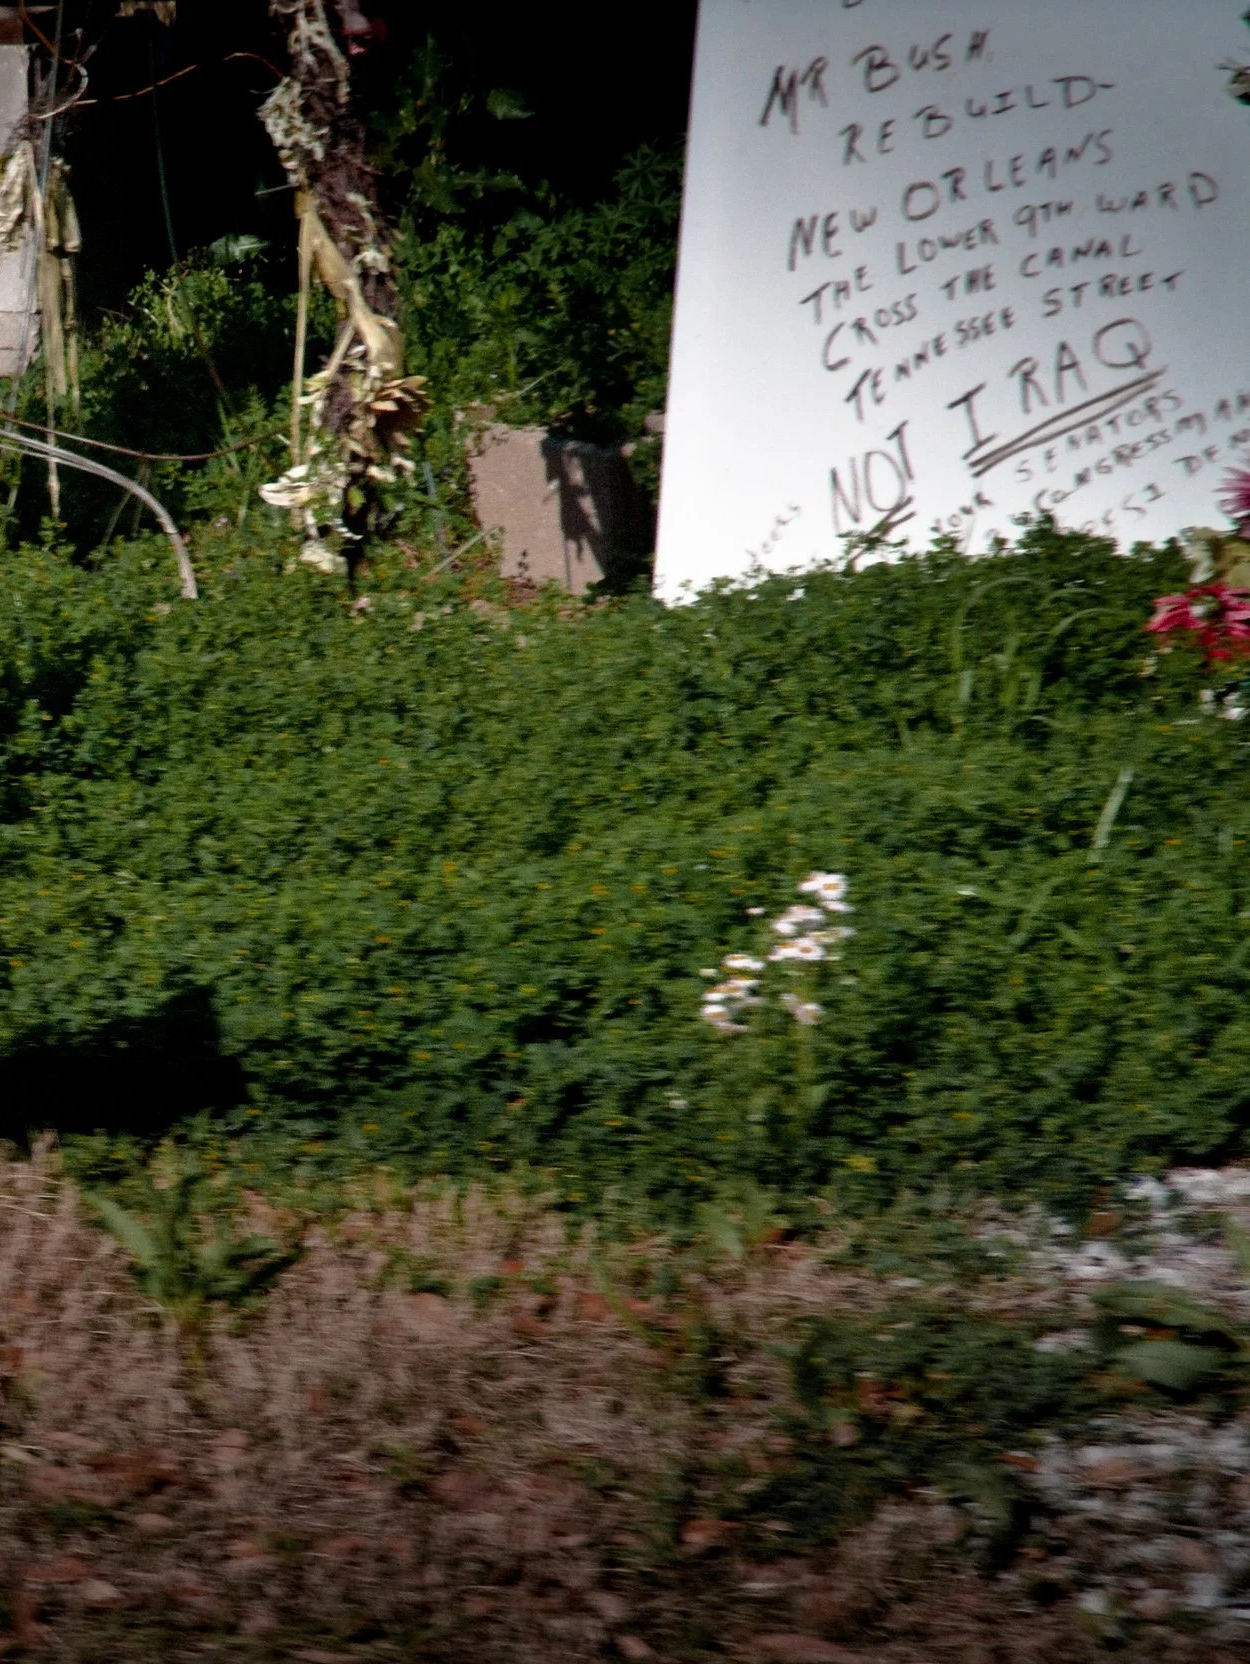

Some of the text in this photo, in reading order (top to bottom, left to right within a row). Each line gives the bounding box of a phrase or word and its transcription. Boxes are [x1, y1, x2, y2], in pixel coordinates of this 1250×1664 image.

[759, 55, 829, 134] MR
[788, 129, 1114, 272] NEW ORLEANS
[800, 172, 1220, 325] THE LOWER 9TH WARD
[822, 234, 1143, 371] CROSS THE CANAL
[845, 270, 1185, 422] TENNESSEE STREET
[830, 317, 1153, 533] NOT IRAQ
[1014, 389, 1184, 483] SENATORS
